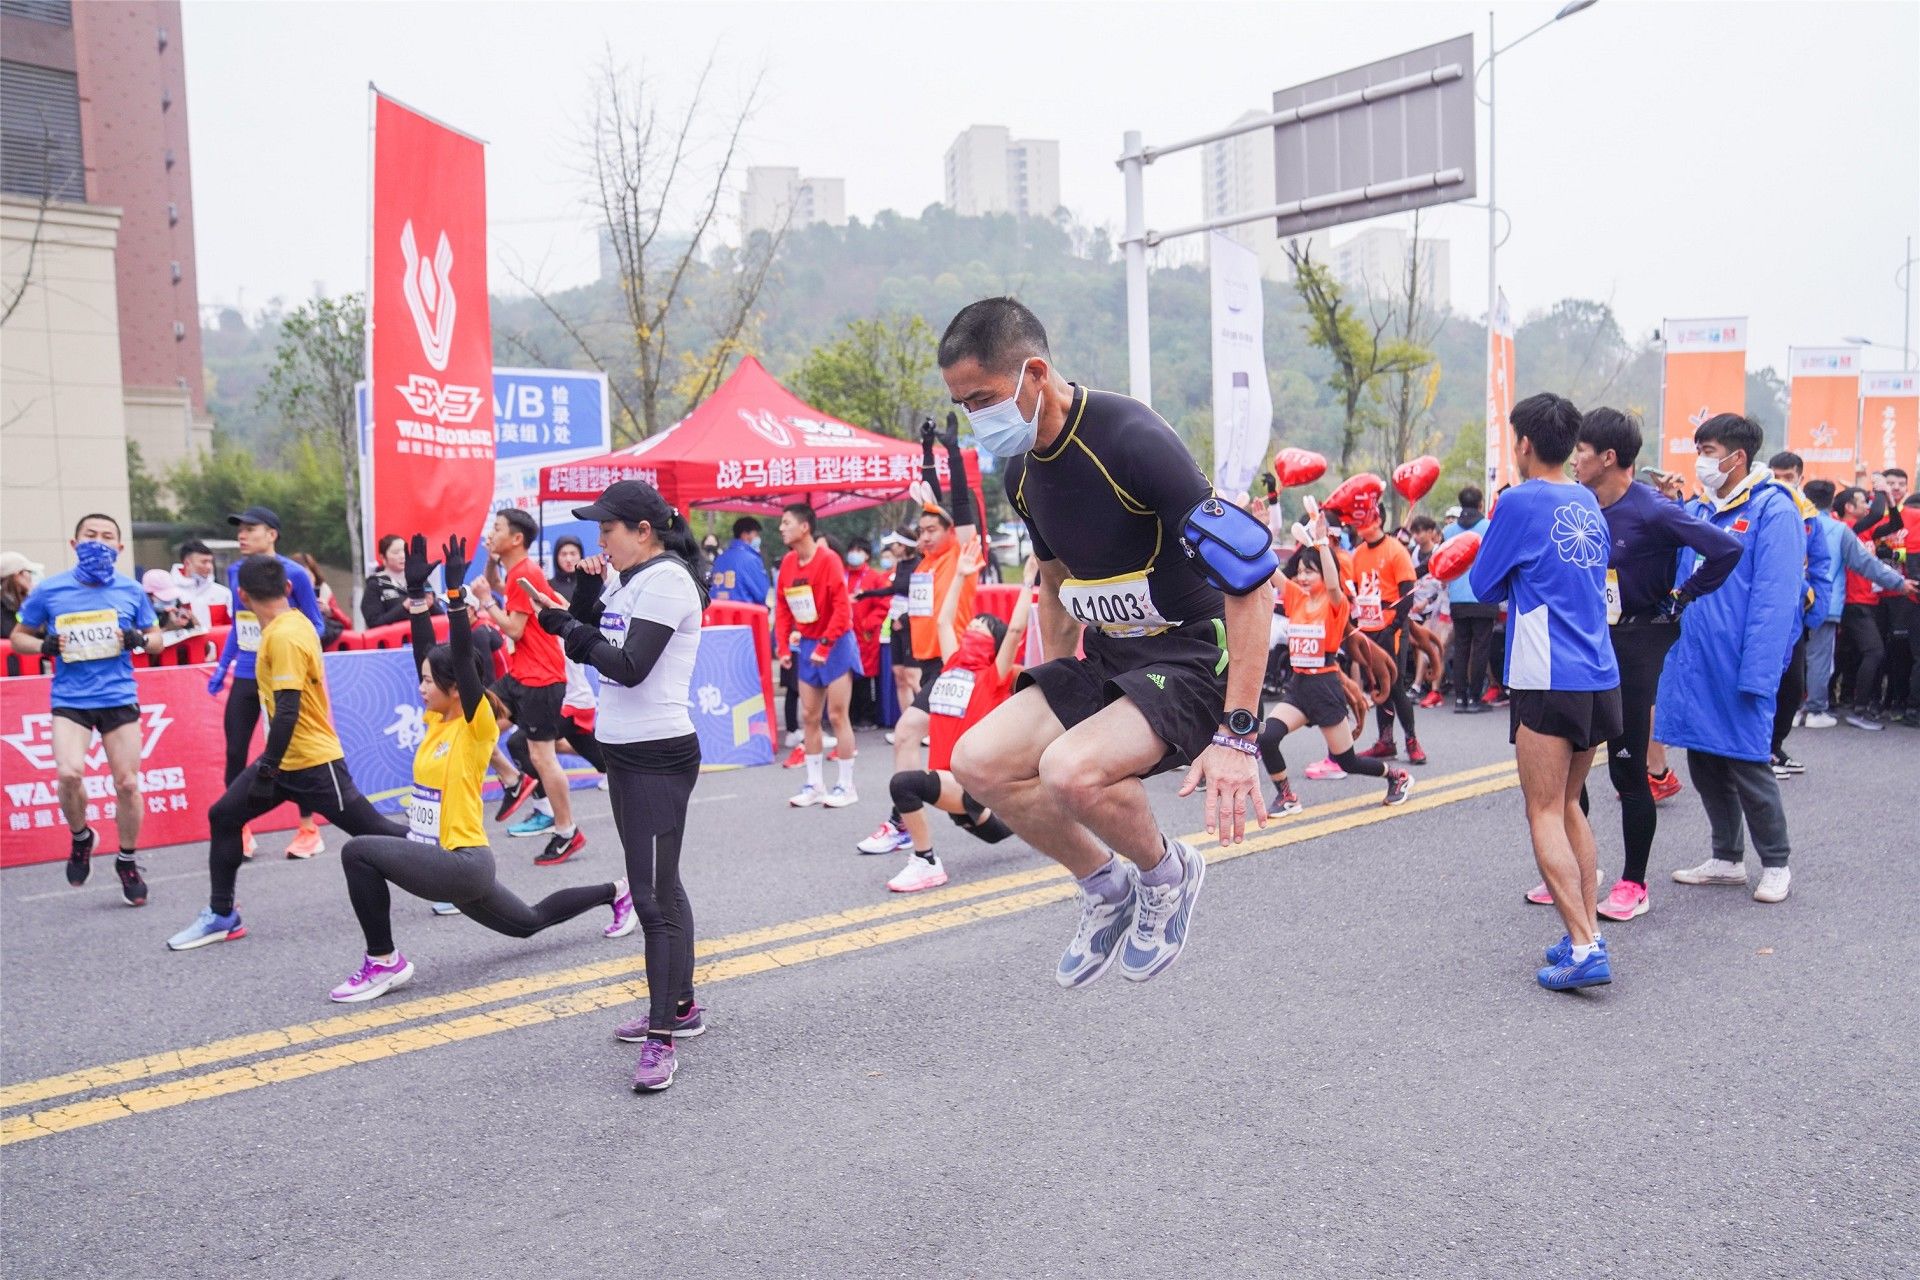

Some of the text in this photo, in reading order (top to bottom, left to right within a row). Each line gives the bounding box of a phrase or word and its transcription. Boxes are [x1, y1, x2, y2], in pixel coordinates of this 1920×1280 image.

[551, 385, 571, 445] 检录处
[495, 422, 551, 445] 英组）
[1072, 592, 1146, 623] A1003
[69, 626, 113, 644] A1032
